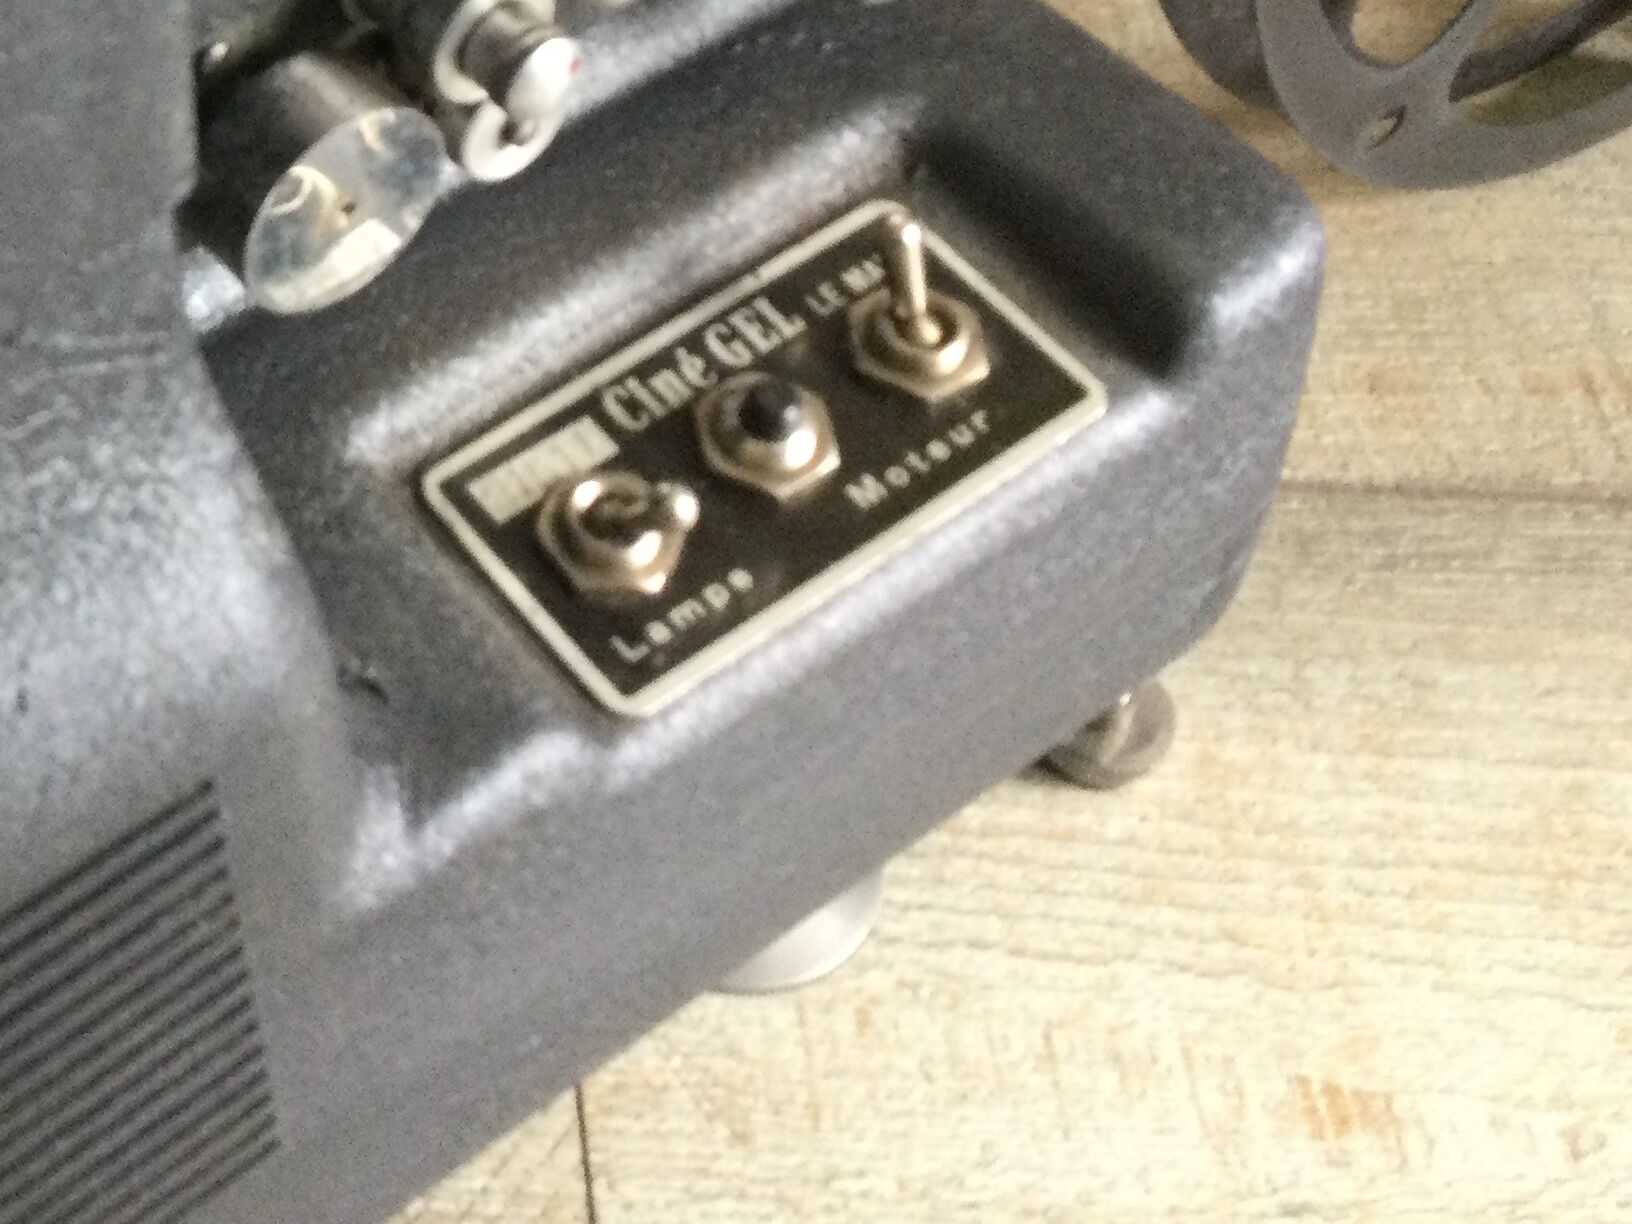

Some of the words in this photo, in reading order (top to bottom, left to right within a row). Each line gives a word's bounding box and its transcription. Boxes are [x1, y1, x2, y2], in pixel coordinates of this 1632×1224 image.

[703, 295, 808, 368] GEL
[843, 410, 993, 511] Moteur
[609, 567, 754, 665] Lampe
